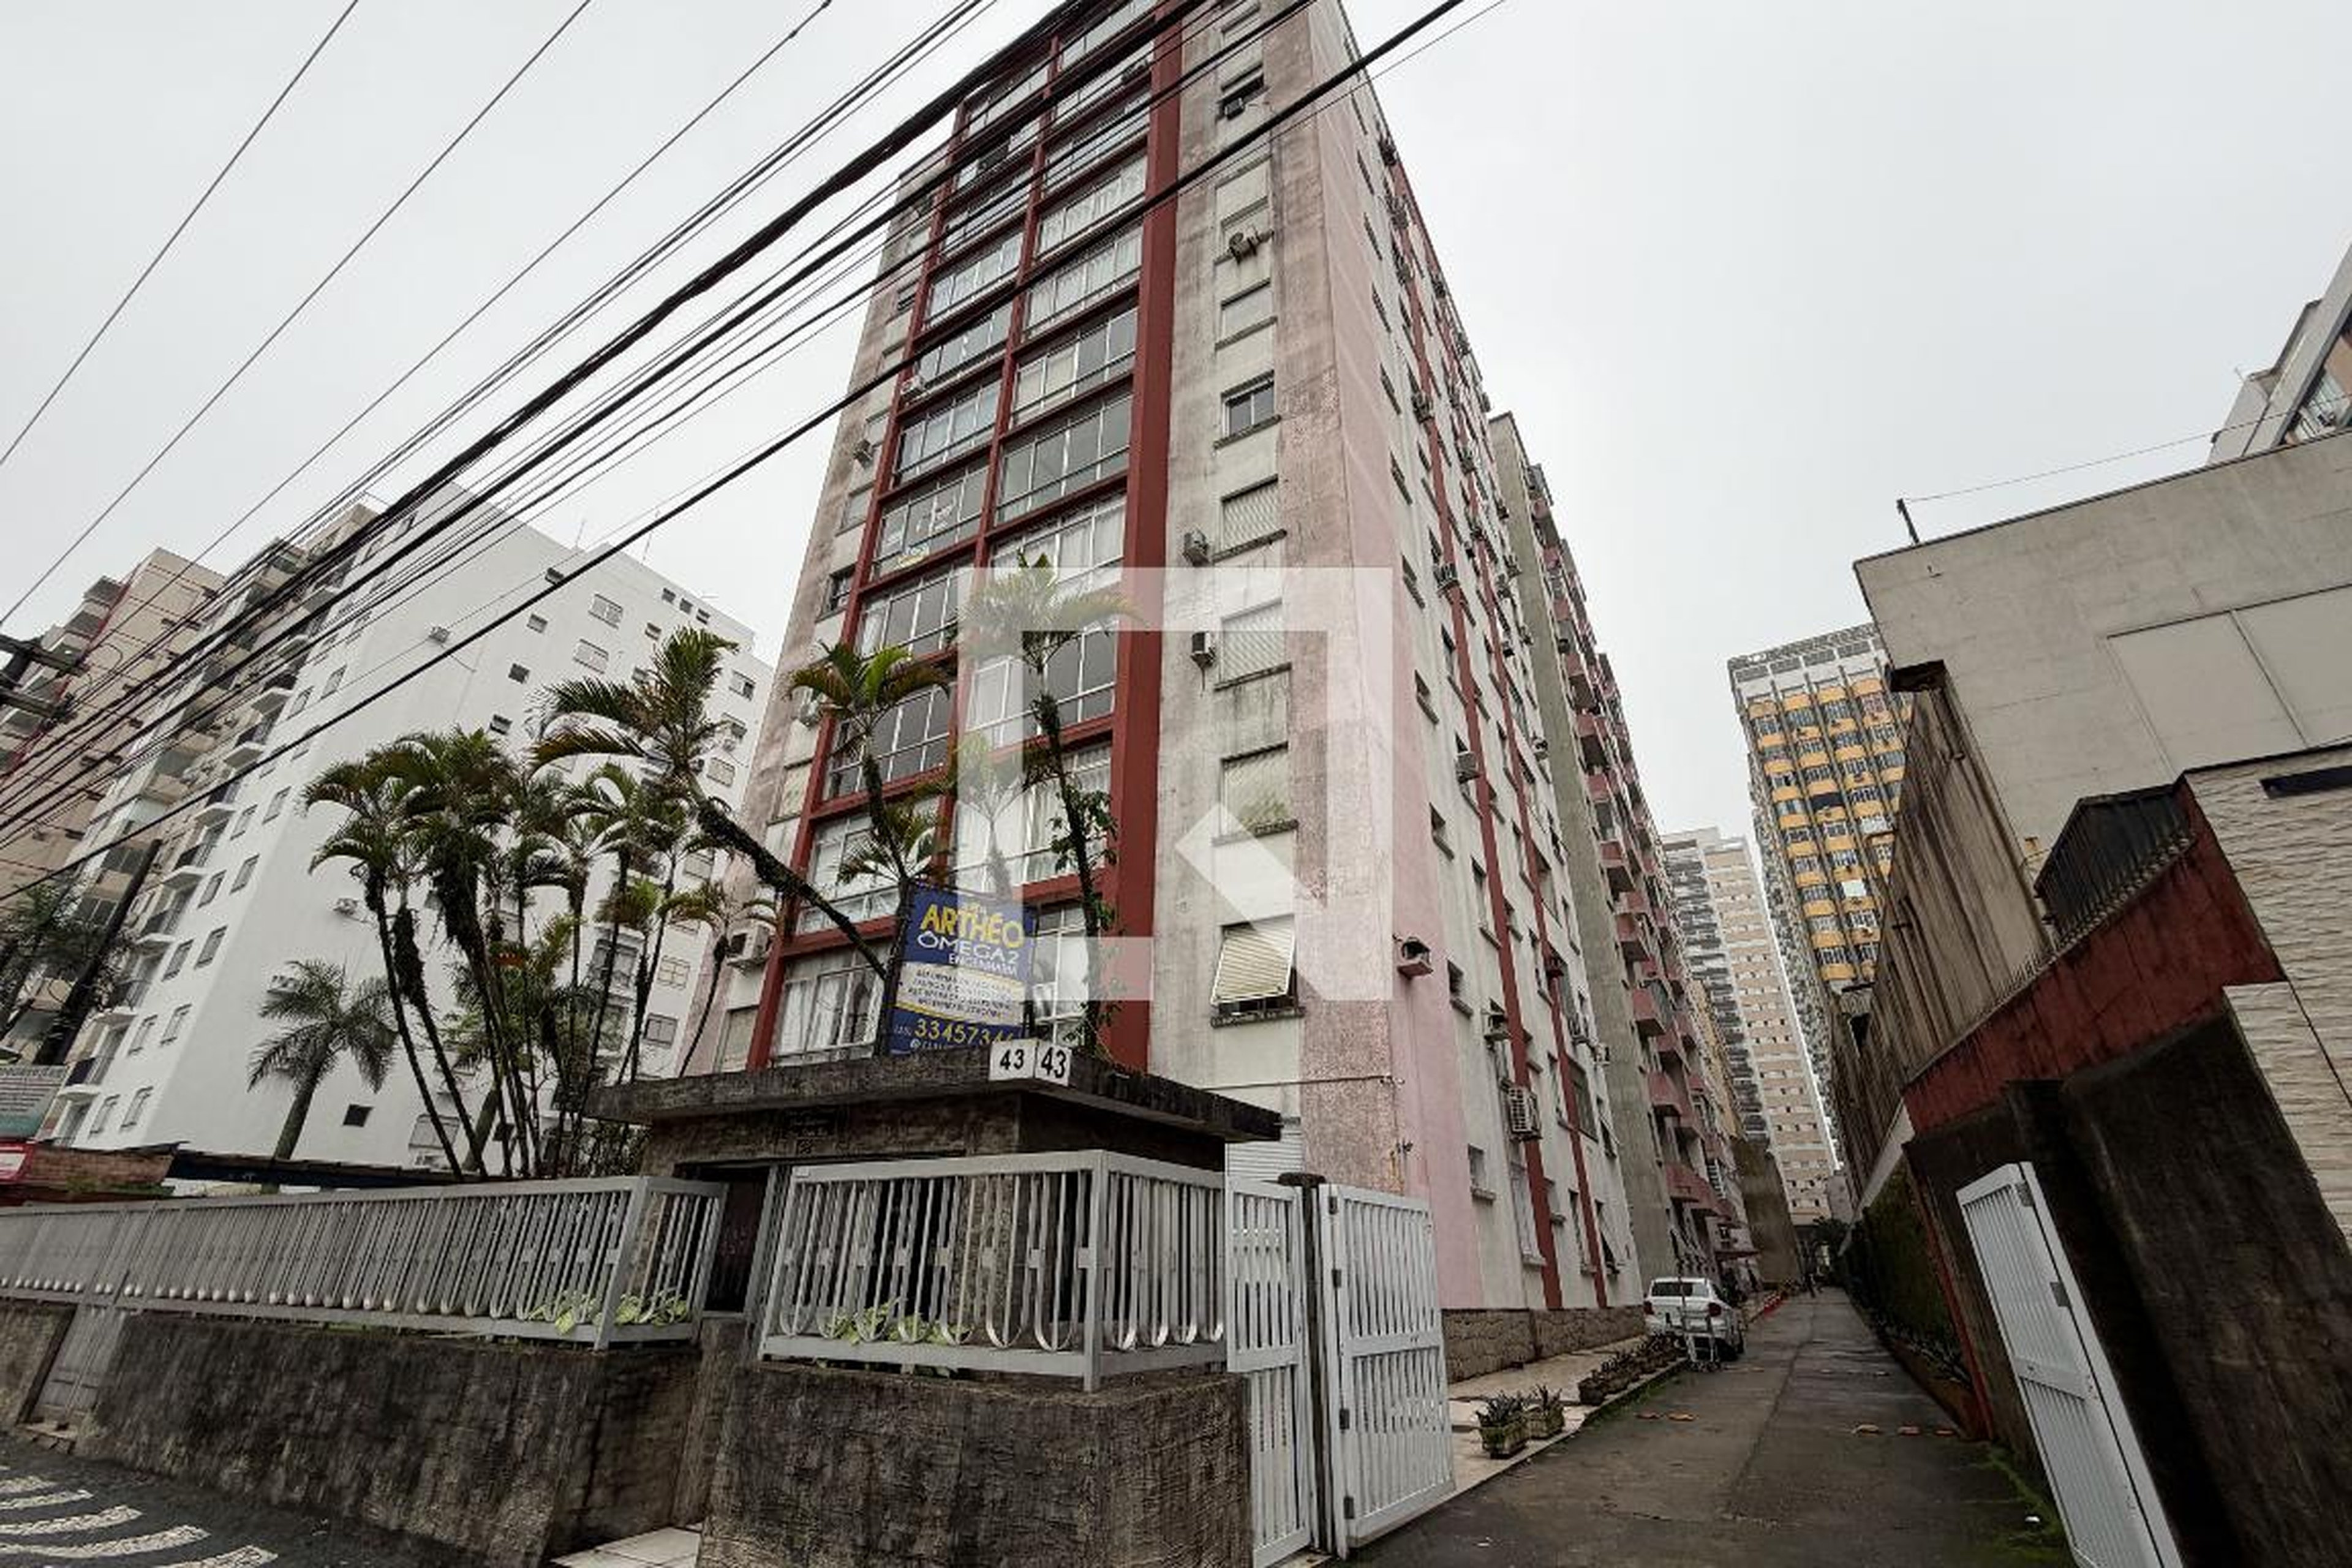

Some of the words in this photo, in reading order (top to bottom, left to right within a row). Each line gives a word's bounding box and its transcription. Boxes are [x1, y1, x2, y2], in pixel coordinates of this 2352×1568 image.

[919, 904, 1023, 948] ARTHEO
[1000, 1049, 1025, 1070] 43
[1041, 1047, 1066, 1079] 43
